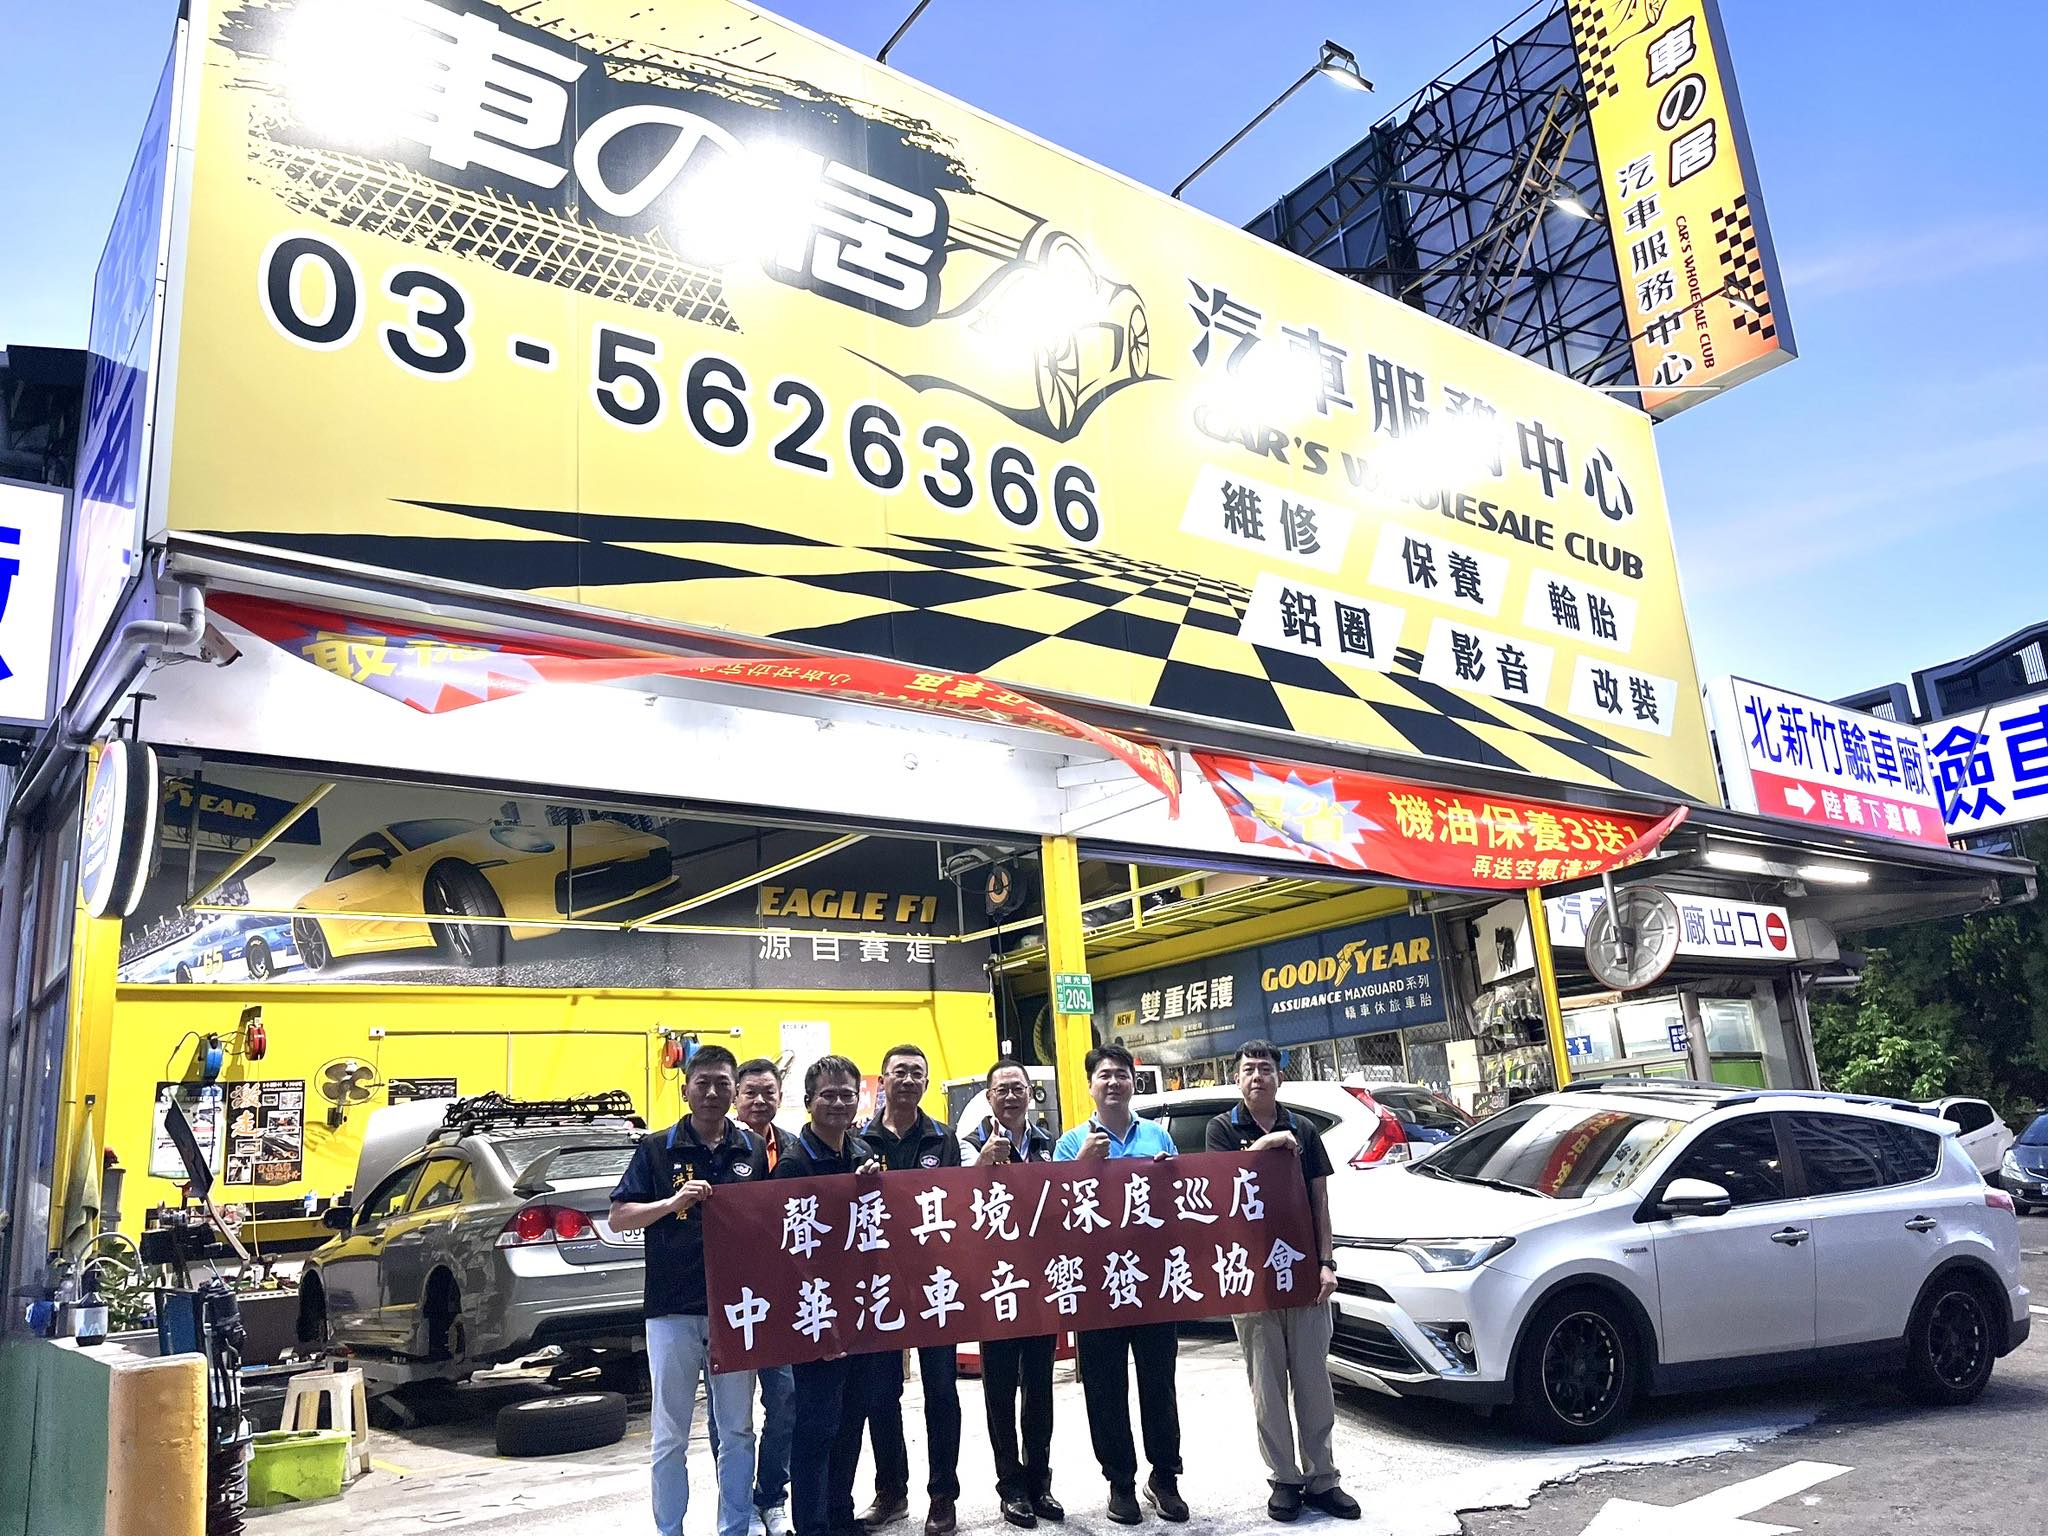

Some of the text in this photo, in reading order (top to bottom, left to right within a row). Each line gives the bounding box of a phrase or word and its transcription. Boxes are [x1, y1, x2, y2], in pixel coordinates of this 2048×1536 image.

[1648, 18, 1716, 187] 車の居
[1618, 153, 1694, 386] 汽車服務中心
[1675, 214, 1692, 255] CAR'S
[1698, 333, 1715, 369] CLUB
[267, 237, 1099, 543] 03-5626366
[1220, 480, 1322, 556] 維修
[1341, 451, 1555, 552] WOLESALE
[1564, 531, 1645, 581] CLUB
[1401, 536, 1485, 605] 保養
[1278, 587, 1376, 659] 鋁圈
[1546, 580, 1619, 642] 輪胎
[1450, 628, 1530, 694] 影音
[1591, 667, 1661, 725] 改裝
[1744, 695, 1931, 797] 北新竹驗車廠
[756, 885, 937, 923] EAGLE F1
[758, 928, 936, 964] 源自賽道
[1260, 936, 1431, 992] GOODYEAR
[1065, 989, 1087, 1009] 209
[1116, 1014, 1131, 1026] NEW
[1139, 975, 1234, 1025] 雙重保護
[1271, 973, 1430, 1014] ASSURANCE MAXGUARD 系列
[1344, 993, 1433, 1020] 轎車休旅車胎
[779, 1167, 1268, 1260] 聲歷其境/深度巡店
[723, 1236, 1307, 1350] 中華汽車音響發展協會
